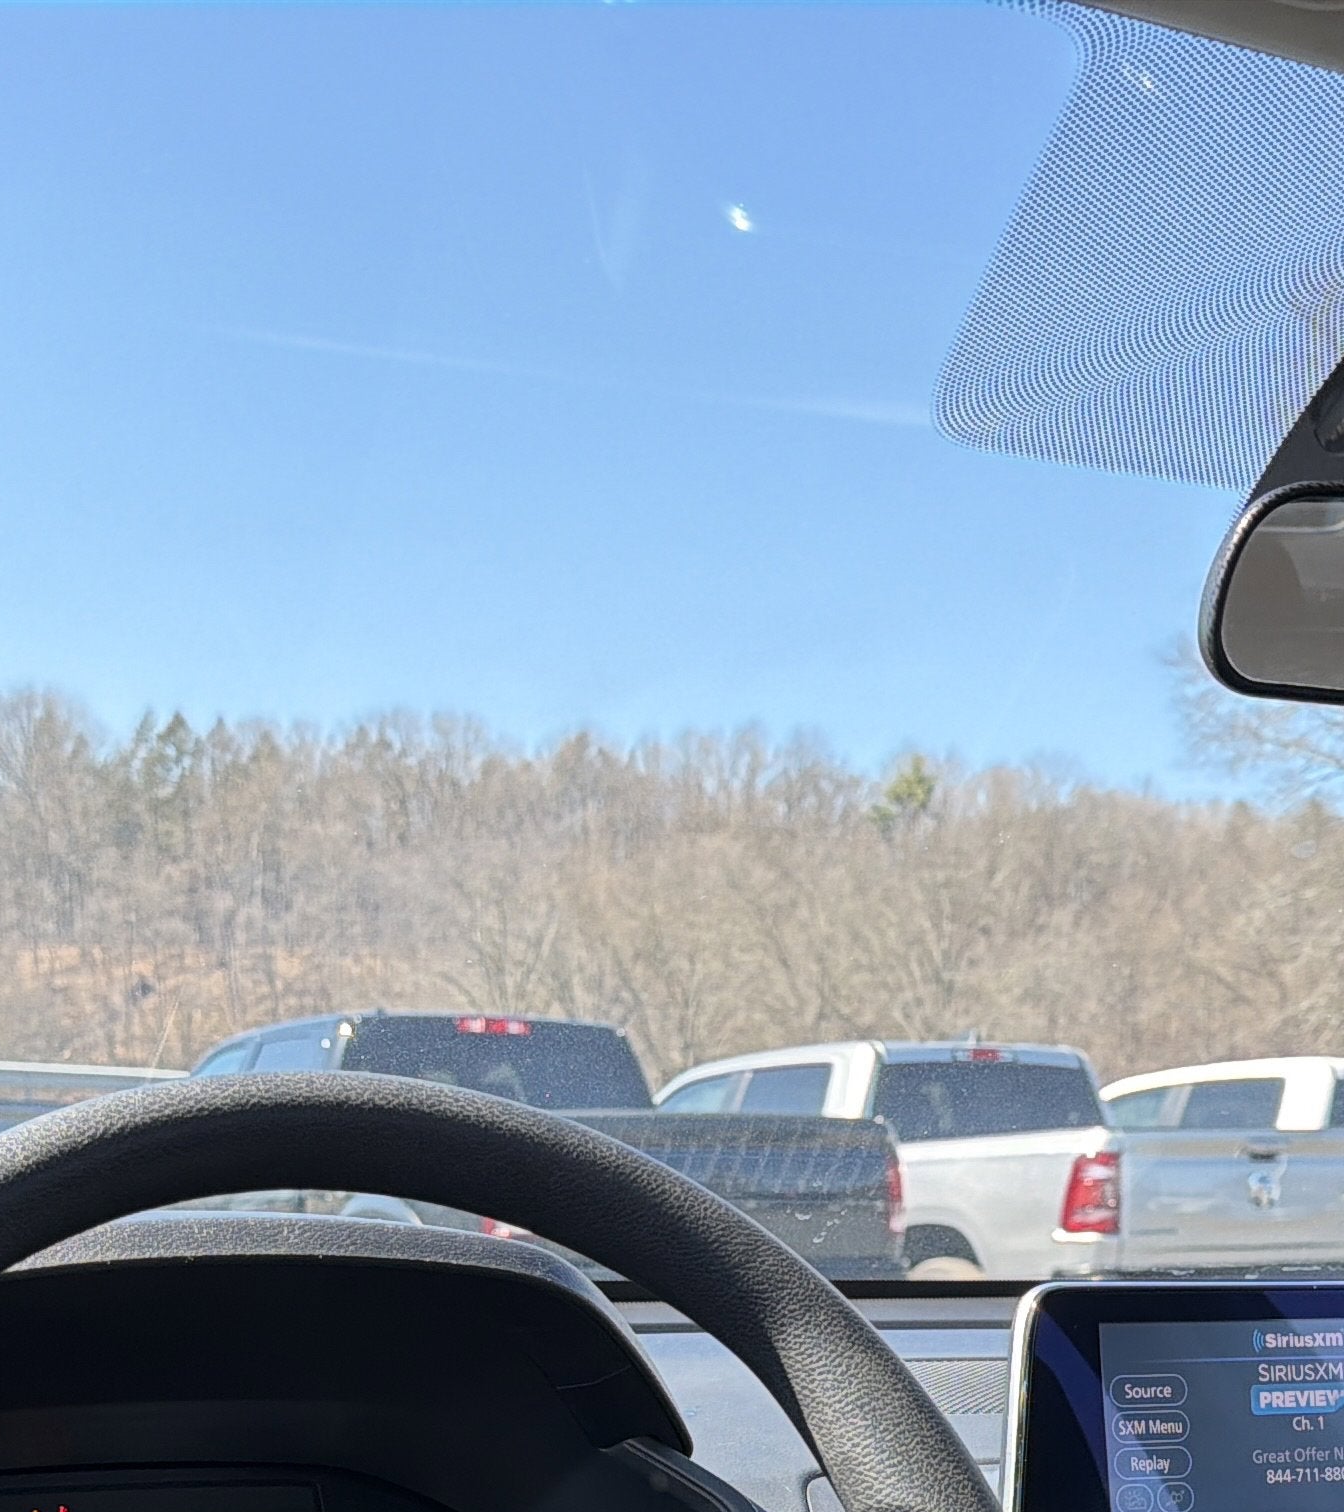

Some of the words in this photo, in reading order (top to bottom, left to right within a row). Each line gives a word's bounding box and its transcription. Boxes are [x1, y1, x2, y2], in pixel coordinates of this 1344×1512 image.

[1258, 1362, 1344, 1382] SIRIUSXM
[1124, 1383, 1172, 1400] Source
[1118, 1419, 1145, 1436] SXM
[1148, 1419, 1183, 1434] Menu
[1292, 1416, 1315, 1432] Ch.
[1319, 1416, 1325, 1430] 1
[1130, 1455, 1170, 1474] Replay
[1252, 1449, 1291, 1465] Great
[1294, 1448, 1331, 1463] Offer
